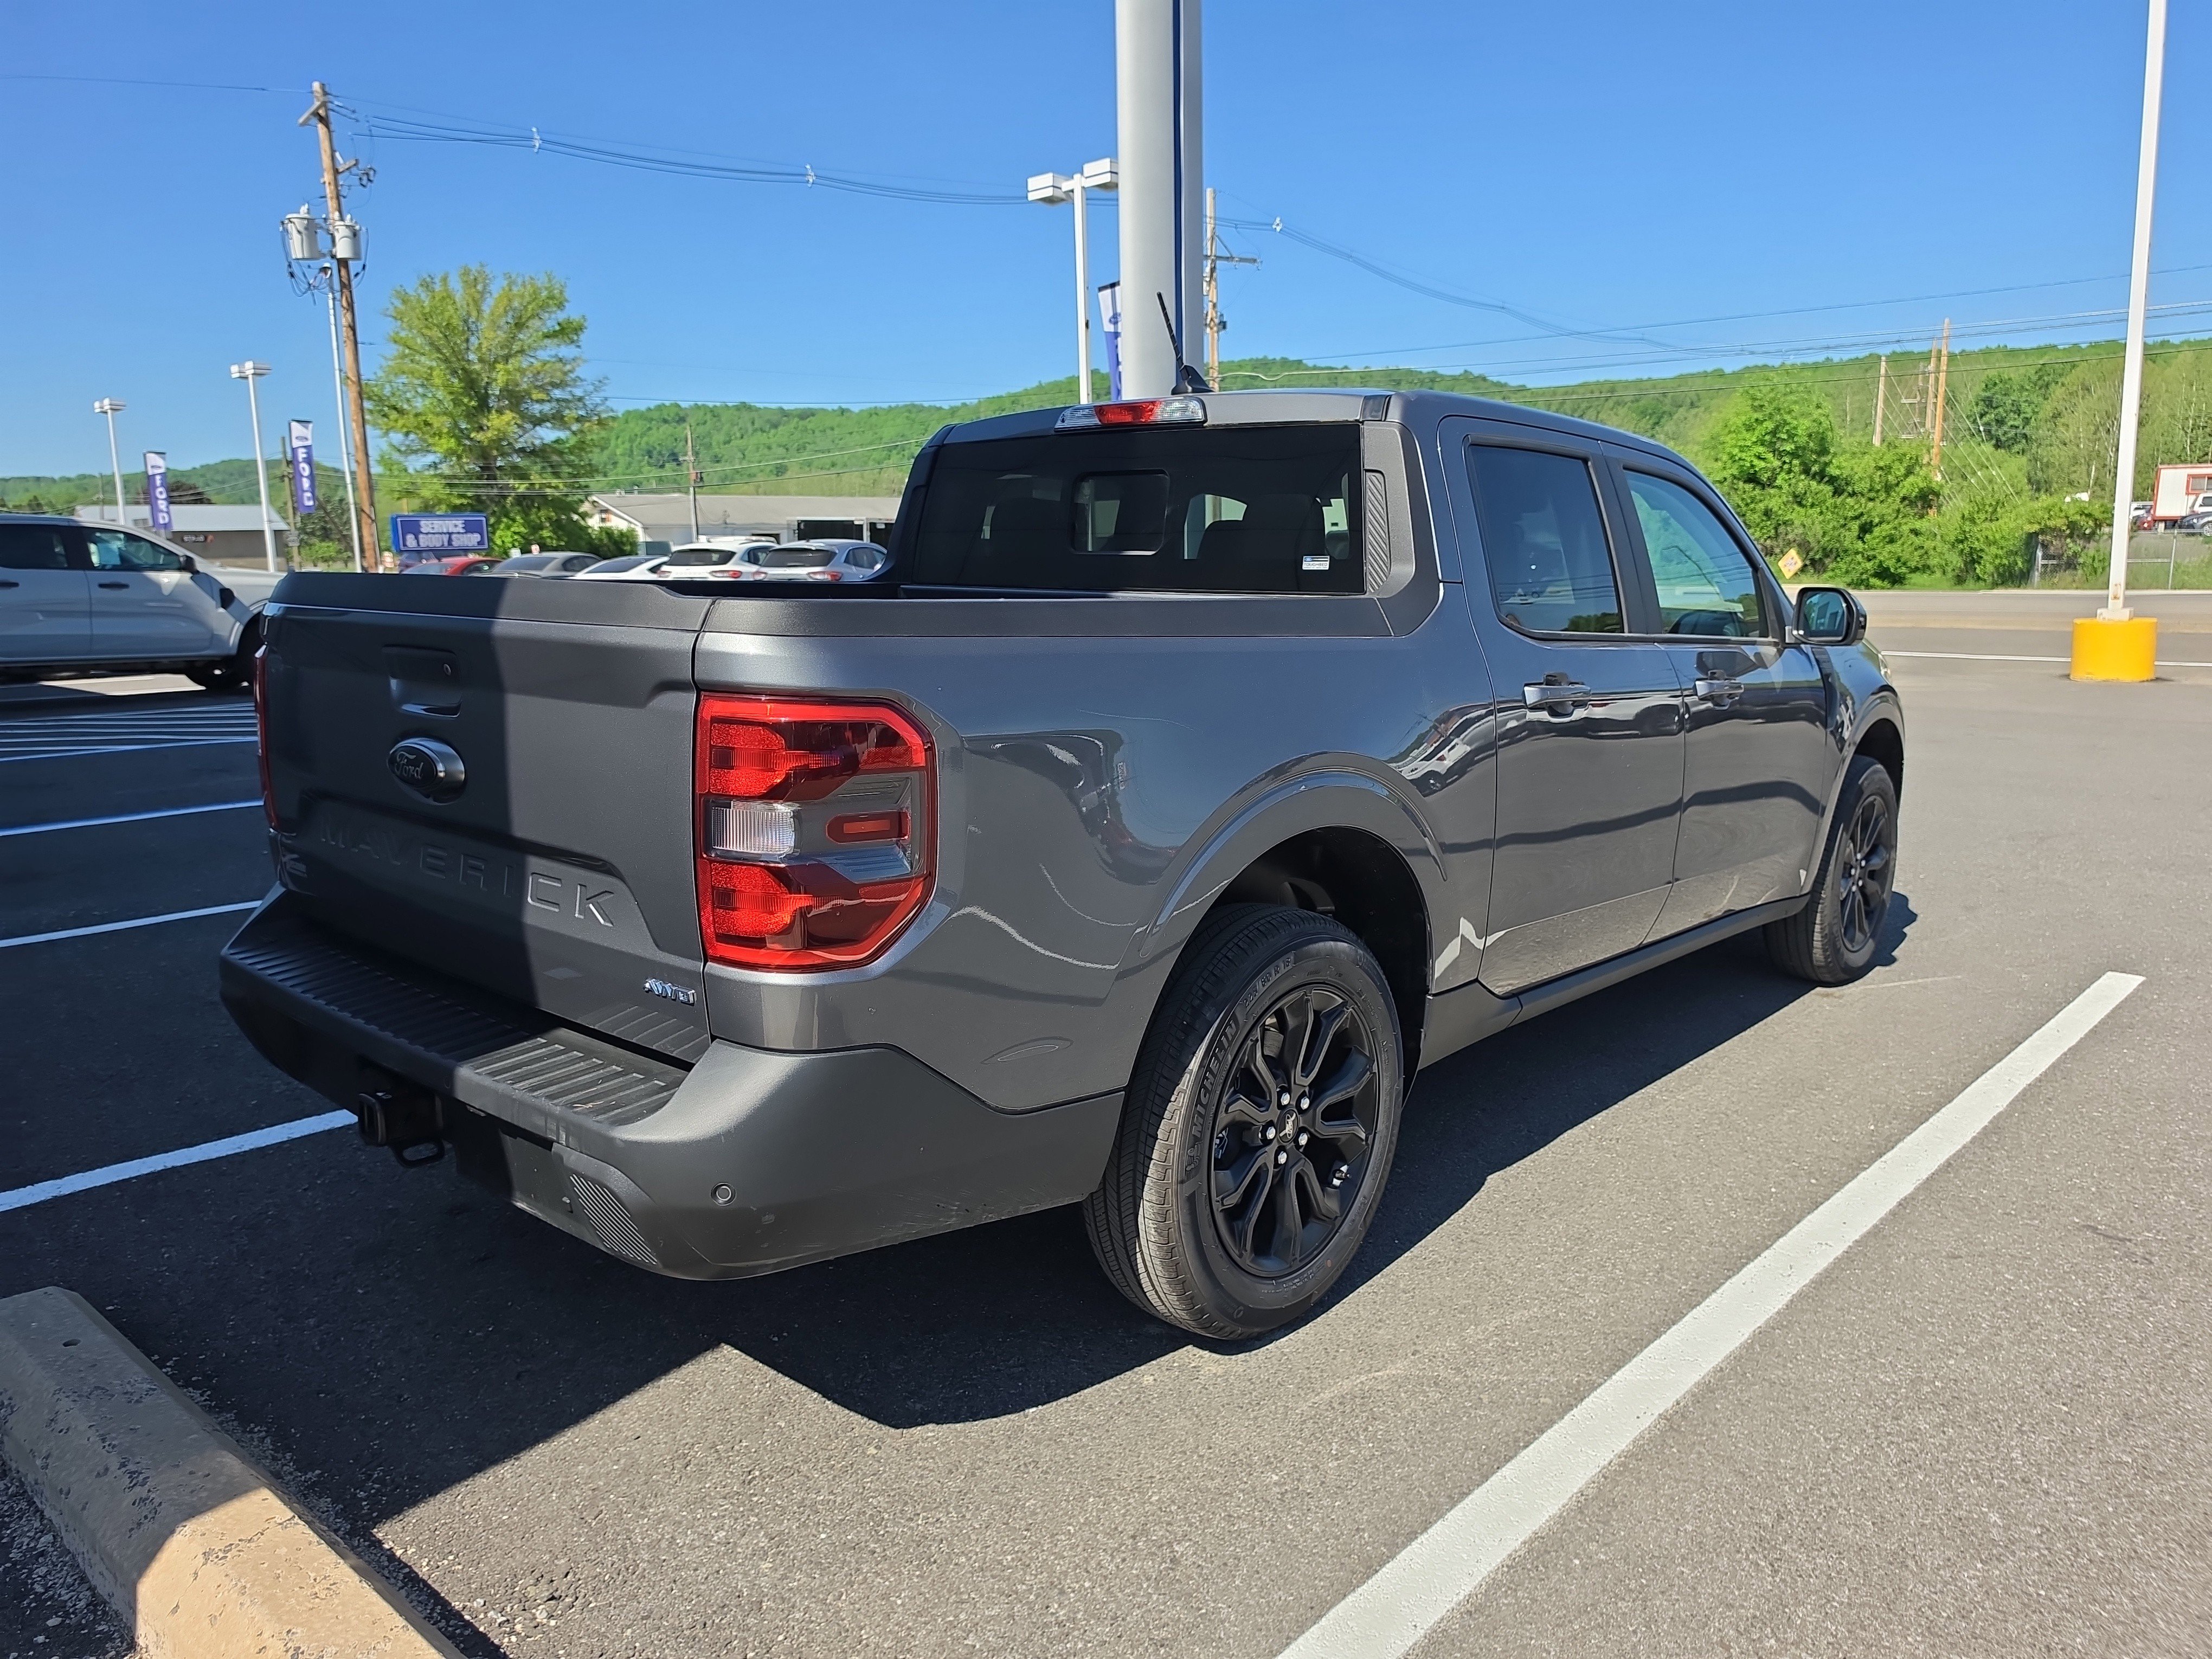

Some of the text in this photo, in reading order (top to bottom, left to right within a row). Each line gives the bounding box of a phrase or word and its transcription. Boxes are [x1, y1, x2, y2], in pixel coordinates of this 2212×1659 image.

[155, 474, 170, 524] FORD
[297, 448, 314, 506] FORD
[406, 532, 481, 548] & BODY SHOP
[420, 520, 466, 533] SERVICE
[394, 751, 424, 780] Ford
[320, 814, 614, 927] MAVERICK
[1192, 1019, 1239, 1138] MICHELIN
